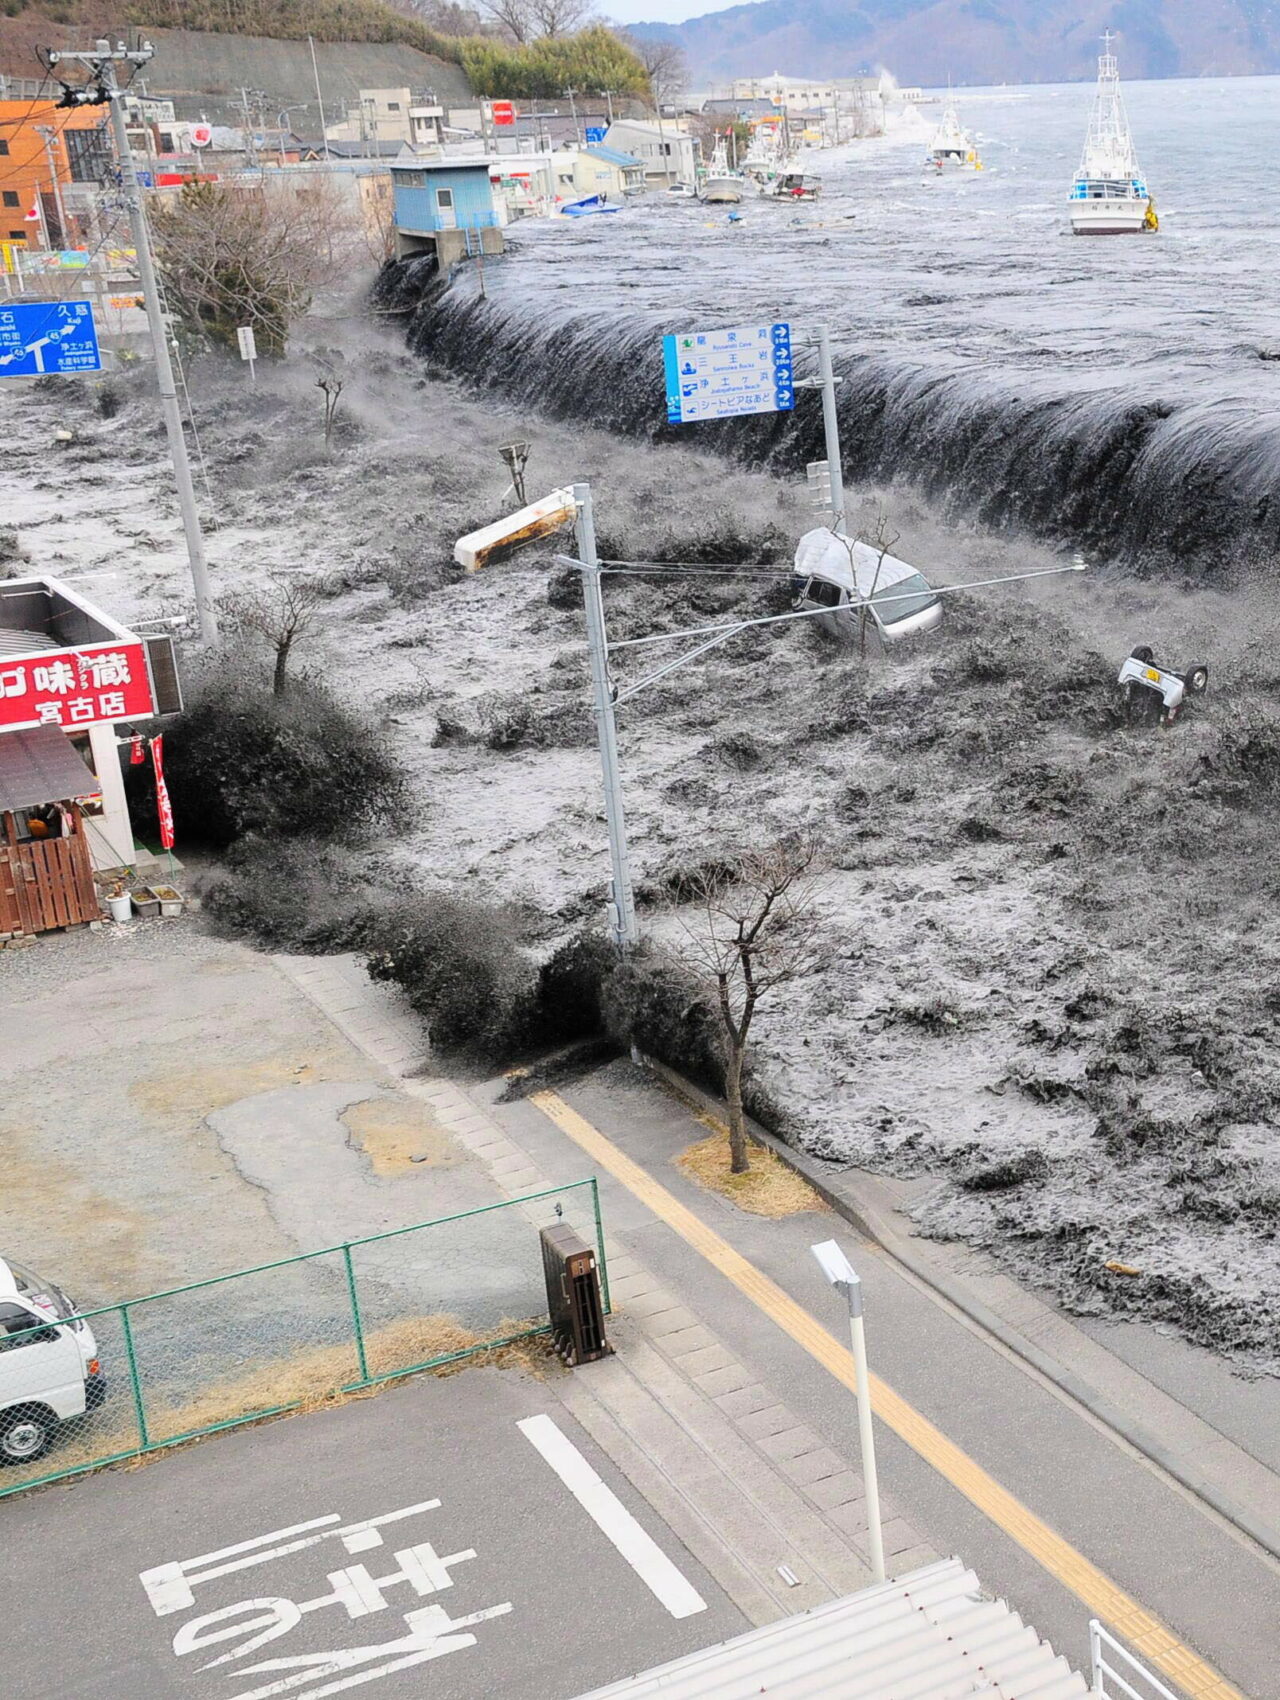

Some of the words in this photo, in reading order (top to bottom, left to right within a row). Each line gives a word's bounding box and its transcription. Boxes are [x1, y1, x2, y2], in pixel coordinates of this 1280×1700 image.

[701, 392, 770, 411] シートピアなあど
[0, 652, 132, 700] プ味蔵
[35, 691, 126, 725] 宮古店
